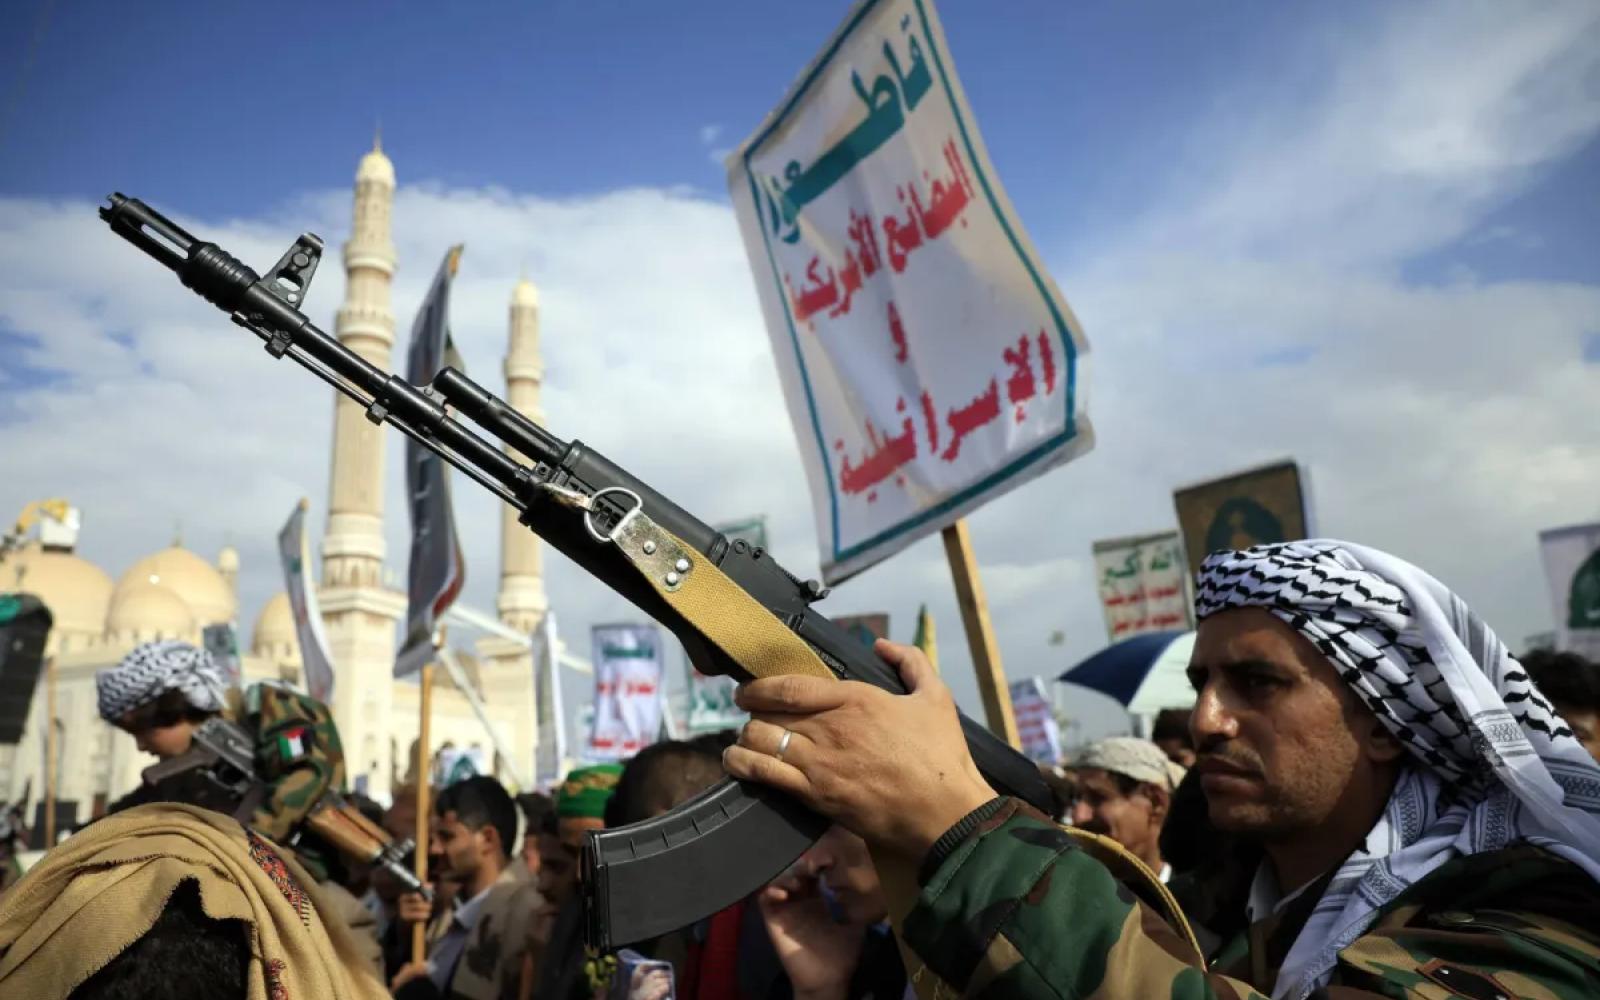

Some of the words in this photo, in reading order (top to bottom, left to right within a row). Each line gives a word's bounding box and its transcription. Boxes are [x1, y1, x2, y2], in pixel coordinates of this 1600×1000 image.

[762, 14, 933, 244] قاطعوا
[884, 134, 976, 275] البضائع
[887, 300, 908, 364] و
[834, 325, 1056, 503] الإسرائيلية
